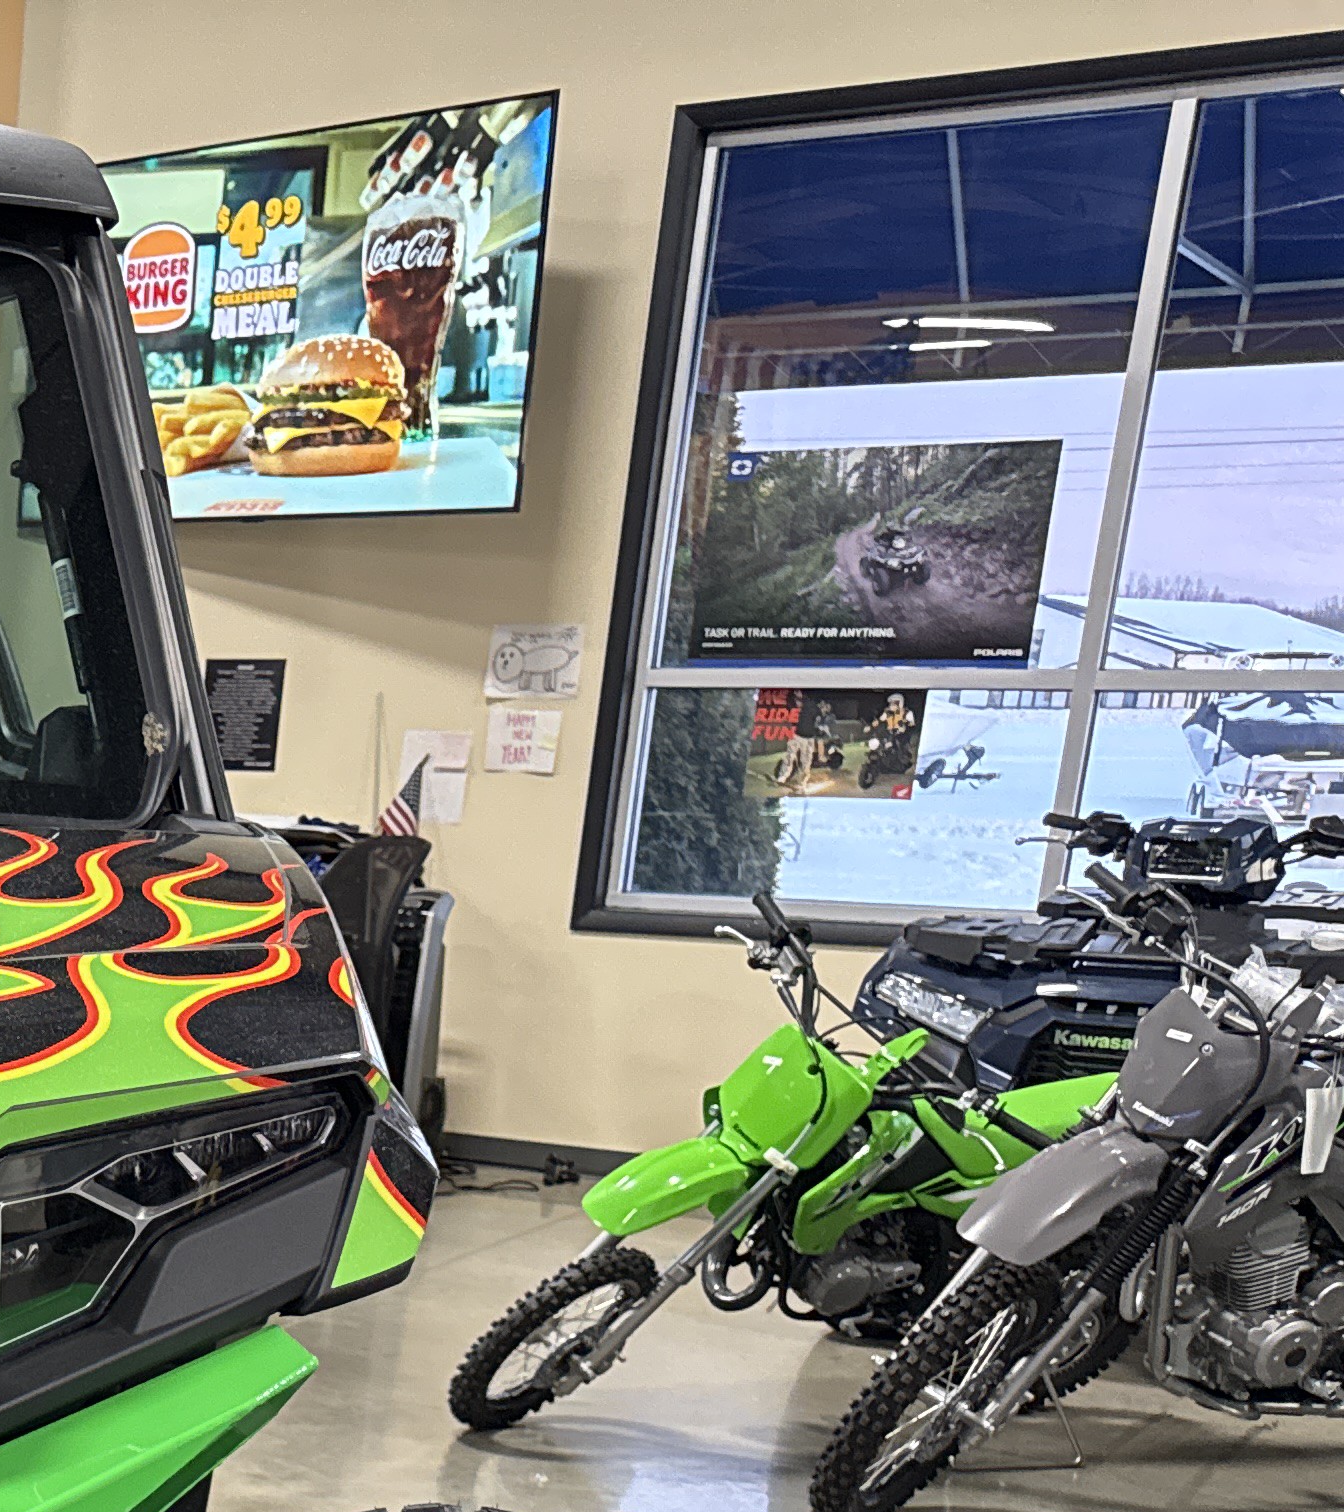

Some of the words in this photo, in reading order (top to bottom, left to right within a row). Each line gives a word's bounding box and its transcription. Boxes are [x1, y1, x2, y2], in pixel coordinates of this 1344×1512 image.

[367, 227, 450, 276] Coca-Cola
[127, 257, 189, 282] BURGER
[215, 261, 299, 293] DOUBLE
[127, 278, 187, 309] KING
[704, 627, 729, 639] TASK
[730, 627, 745, 638] OR
[780, 627, 816, 638] READY
[817, 627, 838, 638] FOR
[973, 648, 1023, 657] POLARIS
[754, 707, 801, 723] RIDE
[752, 725, 797, 741] FUN
[1053, 1029, 1134, 1052] Kawasa
